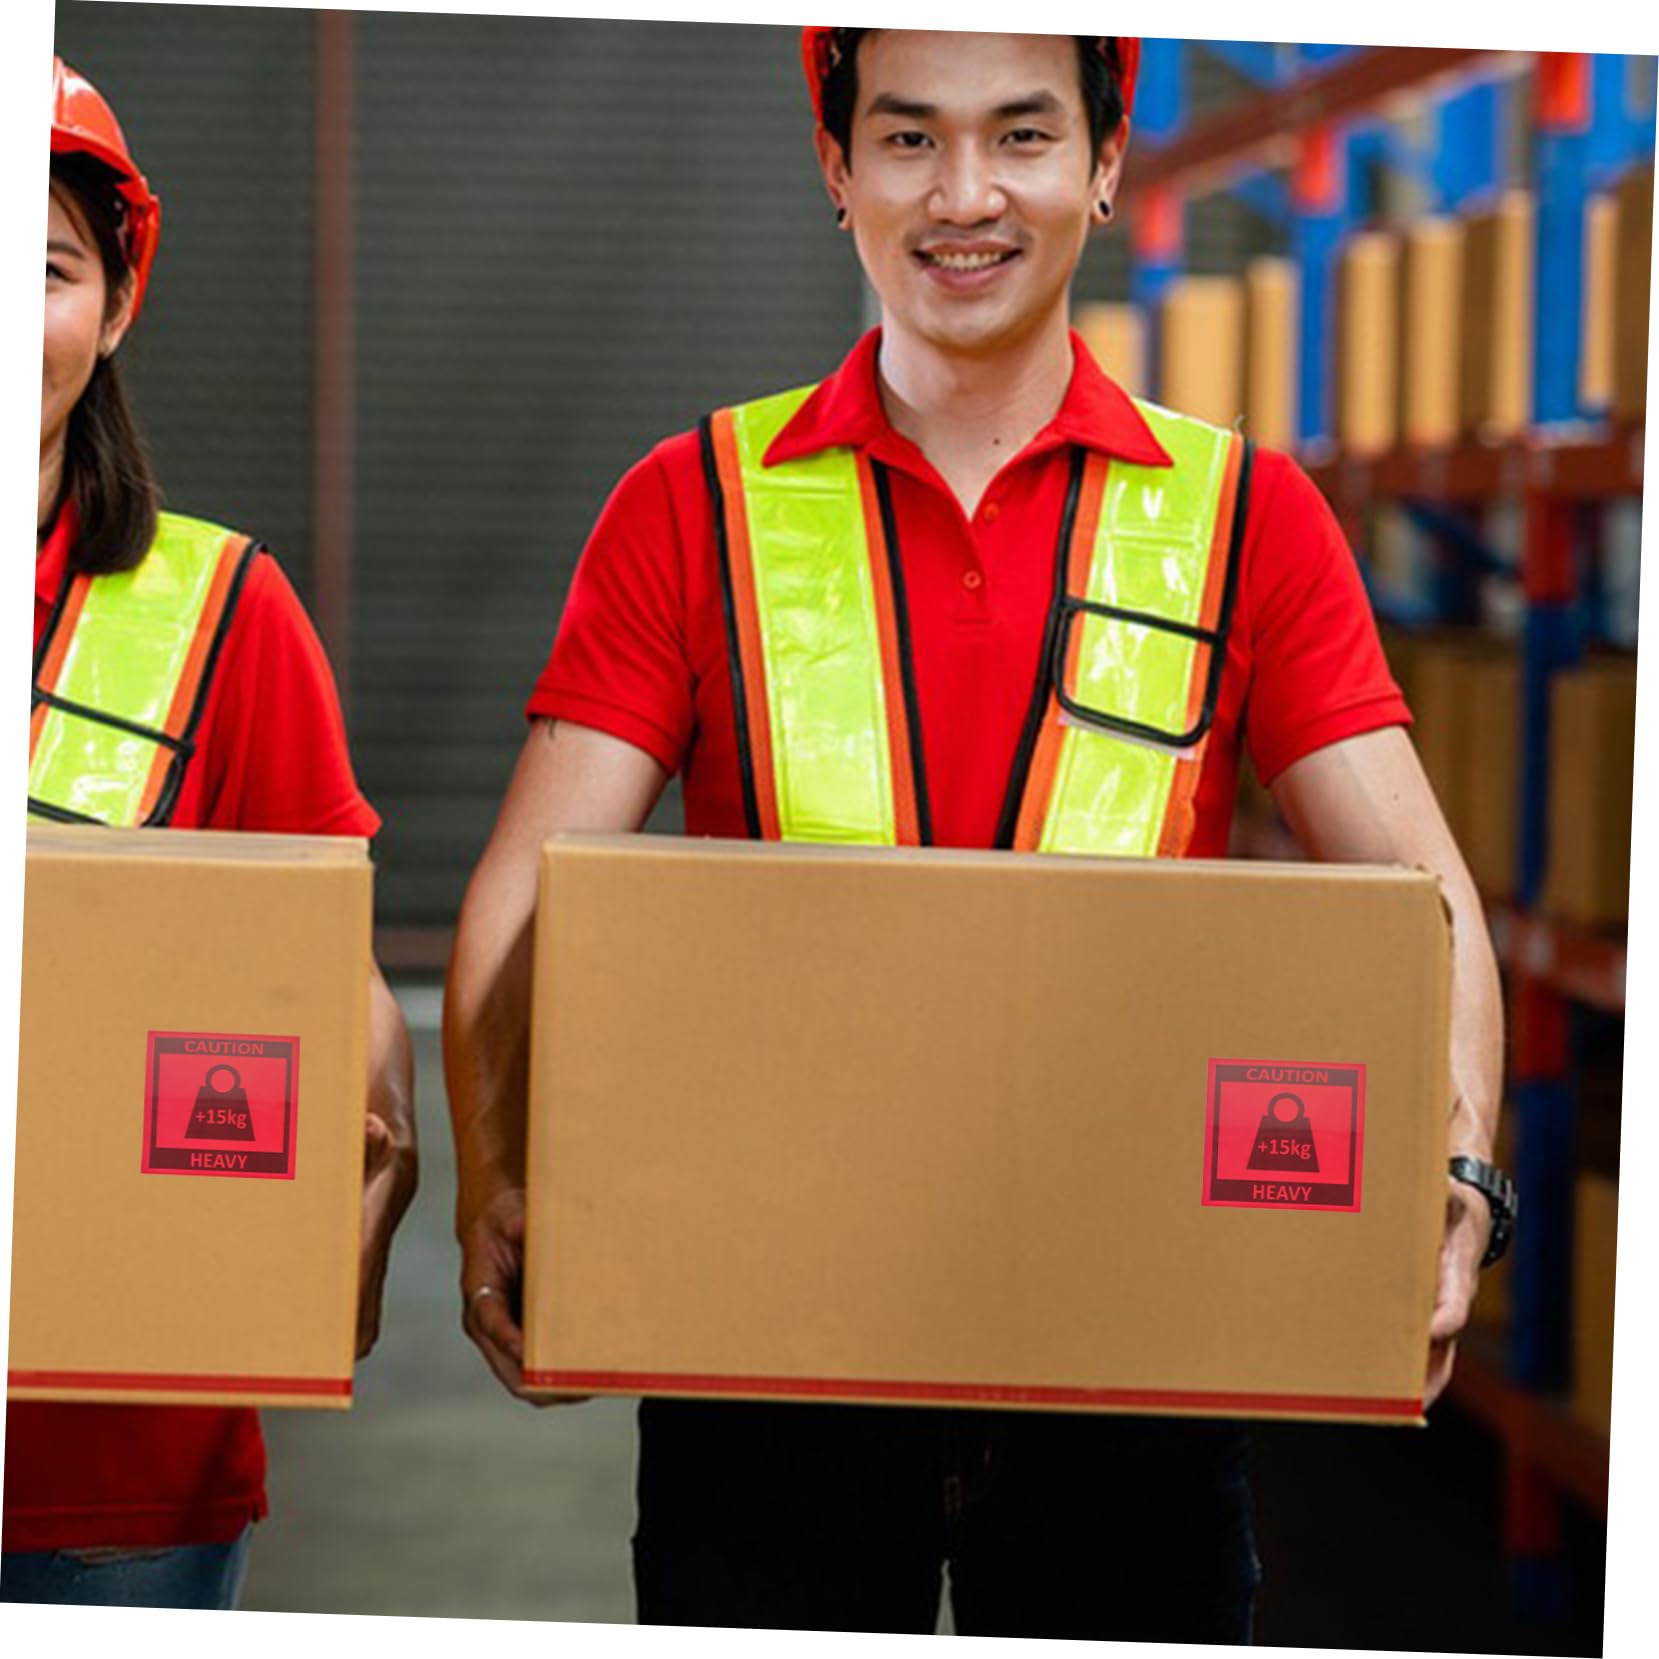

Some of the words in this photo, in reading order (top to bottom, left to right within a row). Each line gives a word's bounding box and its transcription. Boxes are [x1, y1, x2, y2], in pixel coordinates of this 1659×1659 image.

[184, 1040, 264, 1055] CAUTION
[1246, 1068, 1328, 1083] CAUTION
[195, 1109, 247, 1129] +15kg
[1258, 1139, 1312, 1160] +15kg
[190, 1153, 248, 1168] HEAVY
[1252, 1184, 1312, 1201] HEAVY
